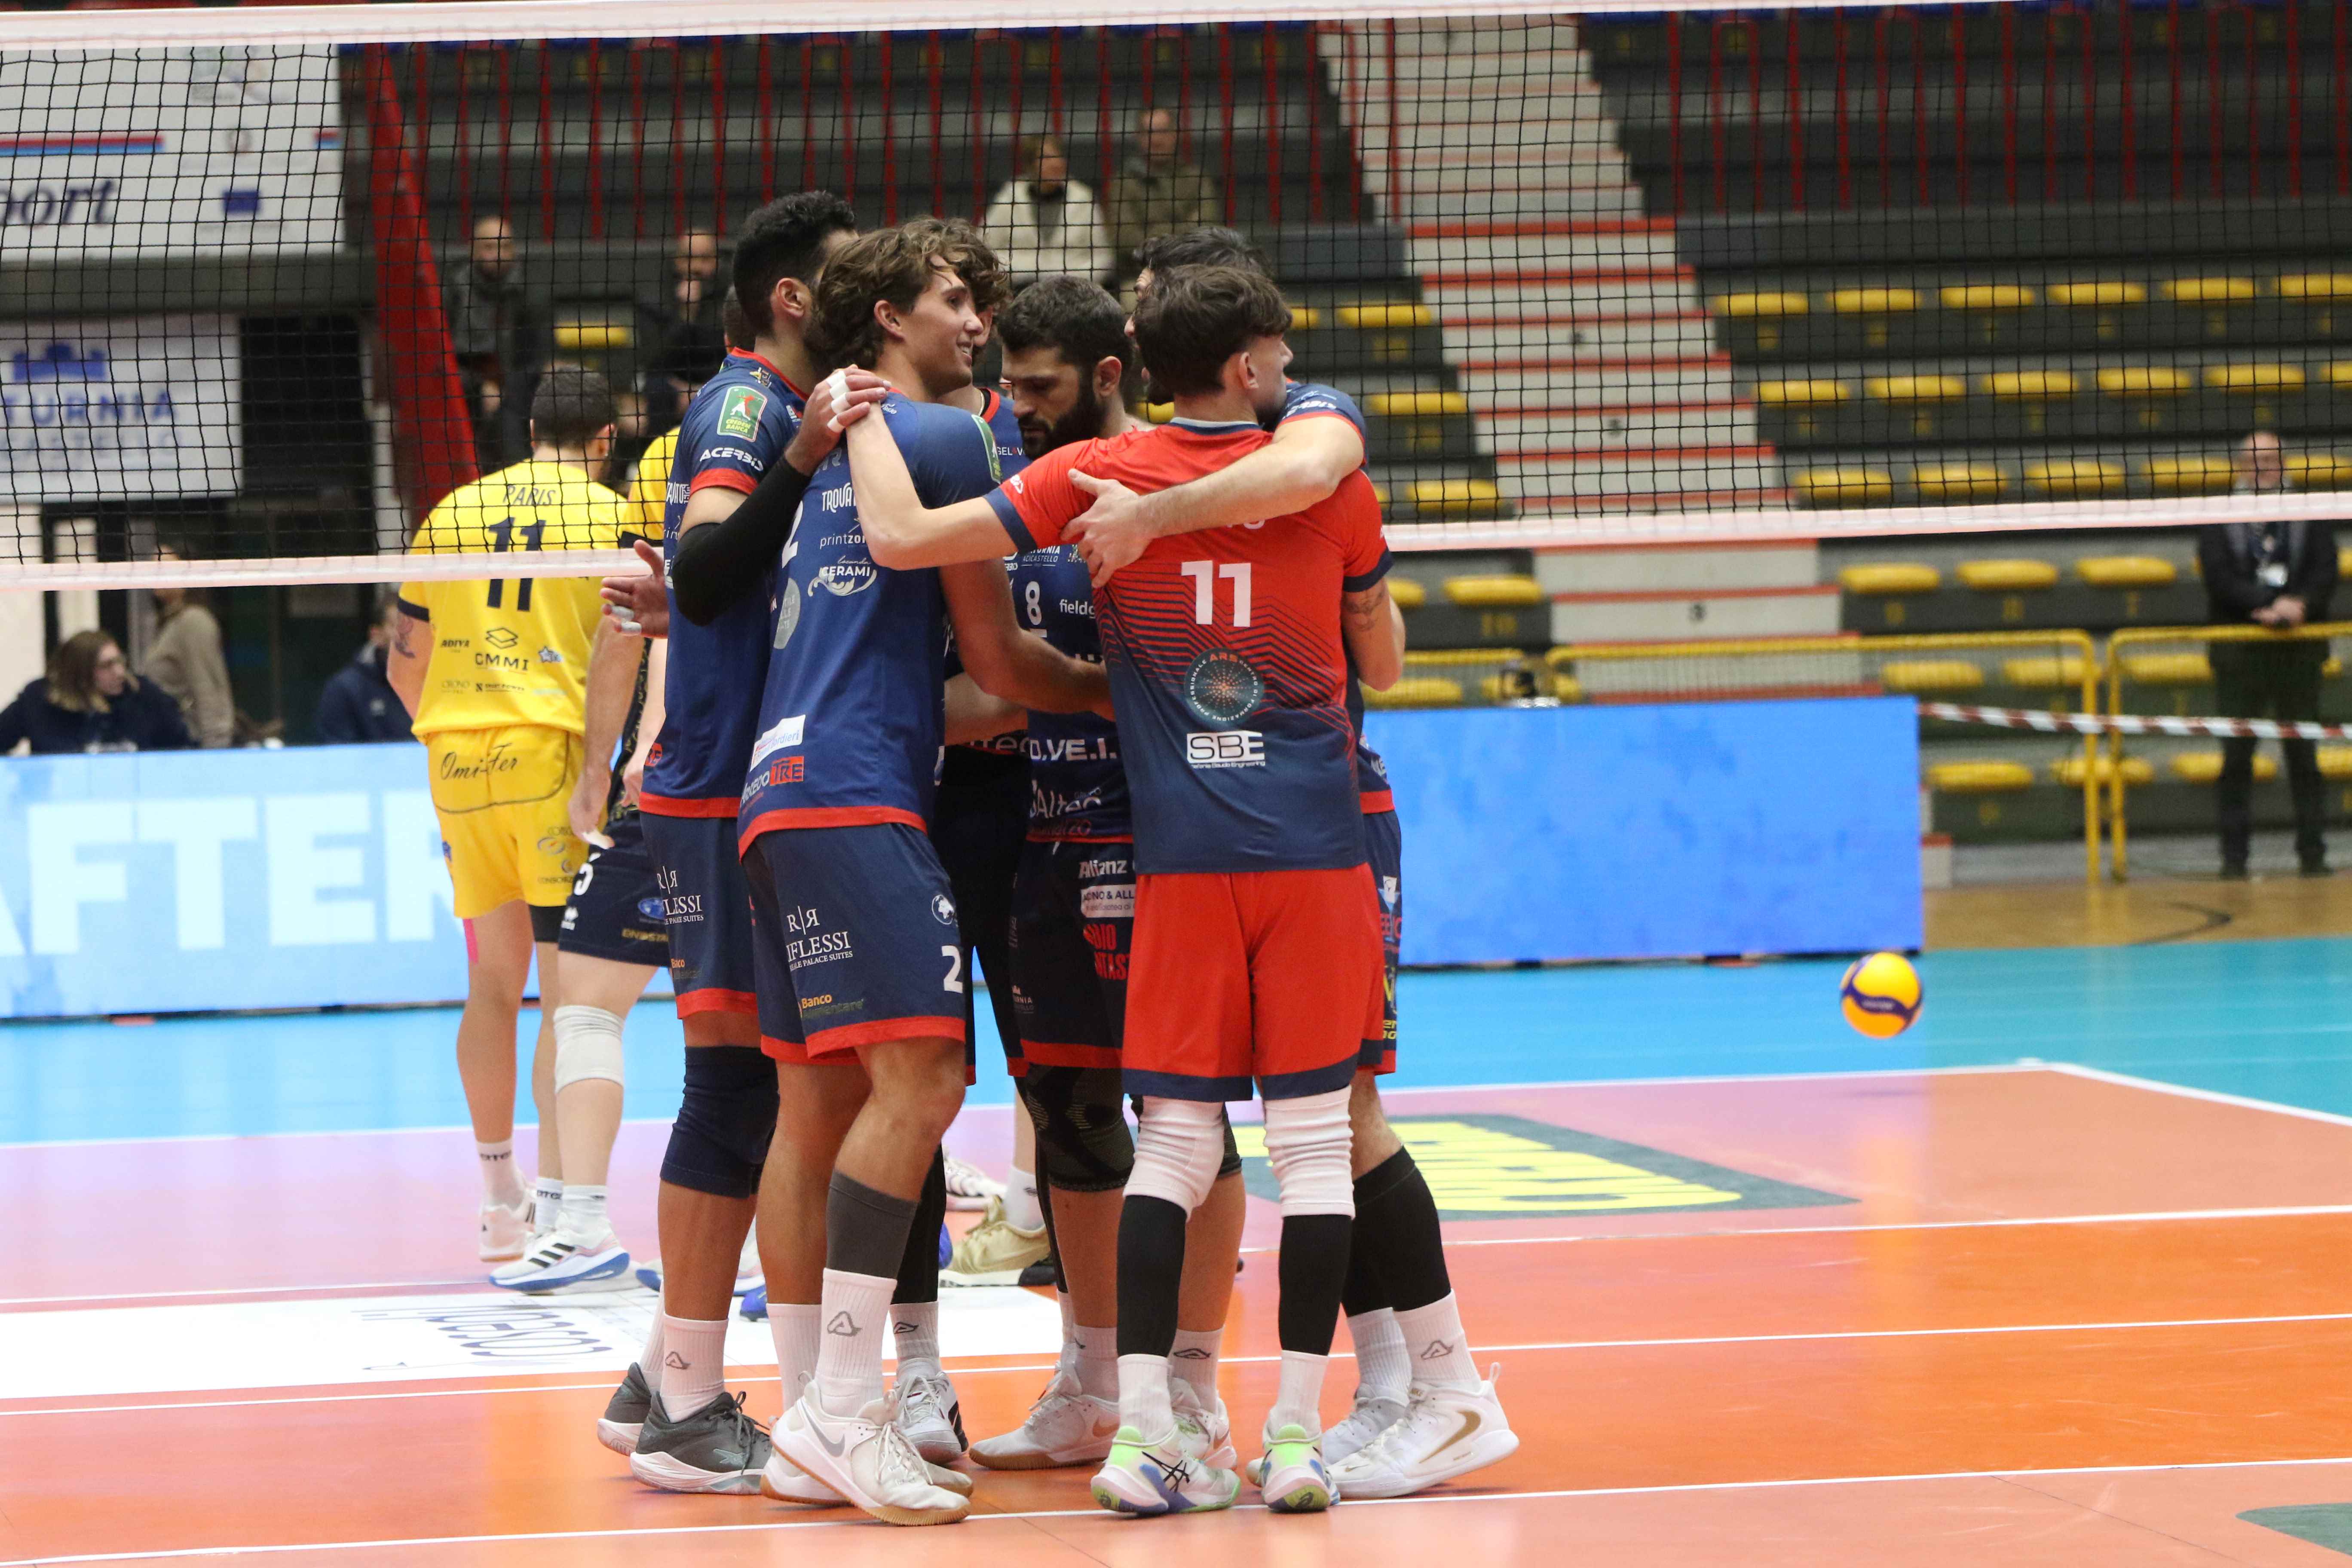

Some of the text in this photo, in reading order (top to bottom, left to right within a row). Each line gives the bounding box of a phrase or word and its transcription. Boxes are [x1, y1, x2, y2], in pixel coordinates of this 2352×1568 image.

[503, 484, 556, 505] PARIS
[487, 517, 546, 612] 11
[821, 566, 870, 577] CERAMI
[1025, 581, 1042, 625] 8
[1181, 560, 1251, 627] 11
[475, 653, 529, 671] CMMI
[1190, 732, 1265, 760] SBE
[772, 760, 802, 782] TRE
[0, 789, 463, 956] FTER
[1078, 860, 1127, 879] Allianz
[803, 955, 828, 968] PALACE
[829, 951, 853, 962] SUITES
[941, 946, 963, 994] 2
[801, 994, 833, 1010] Banco
